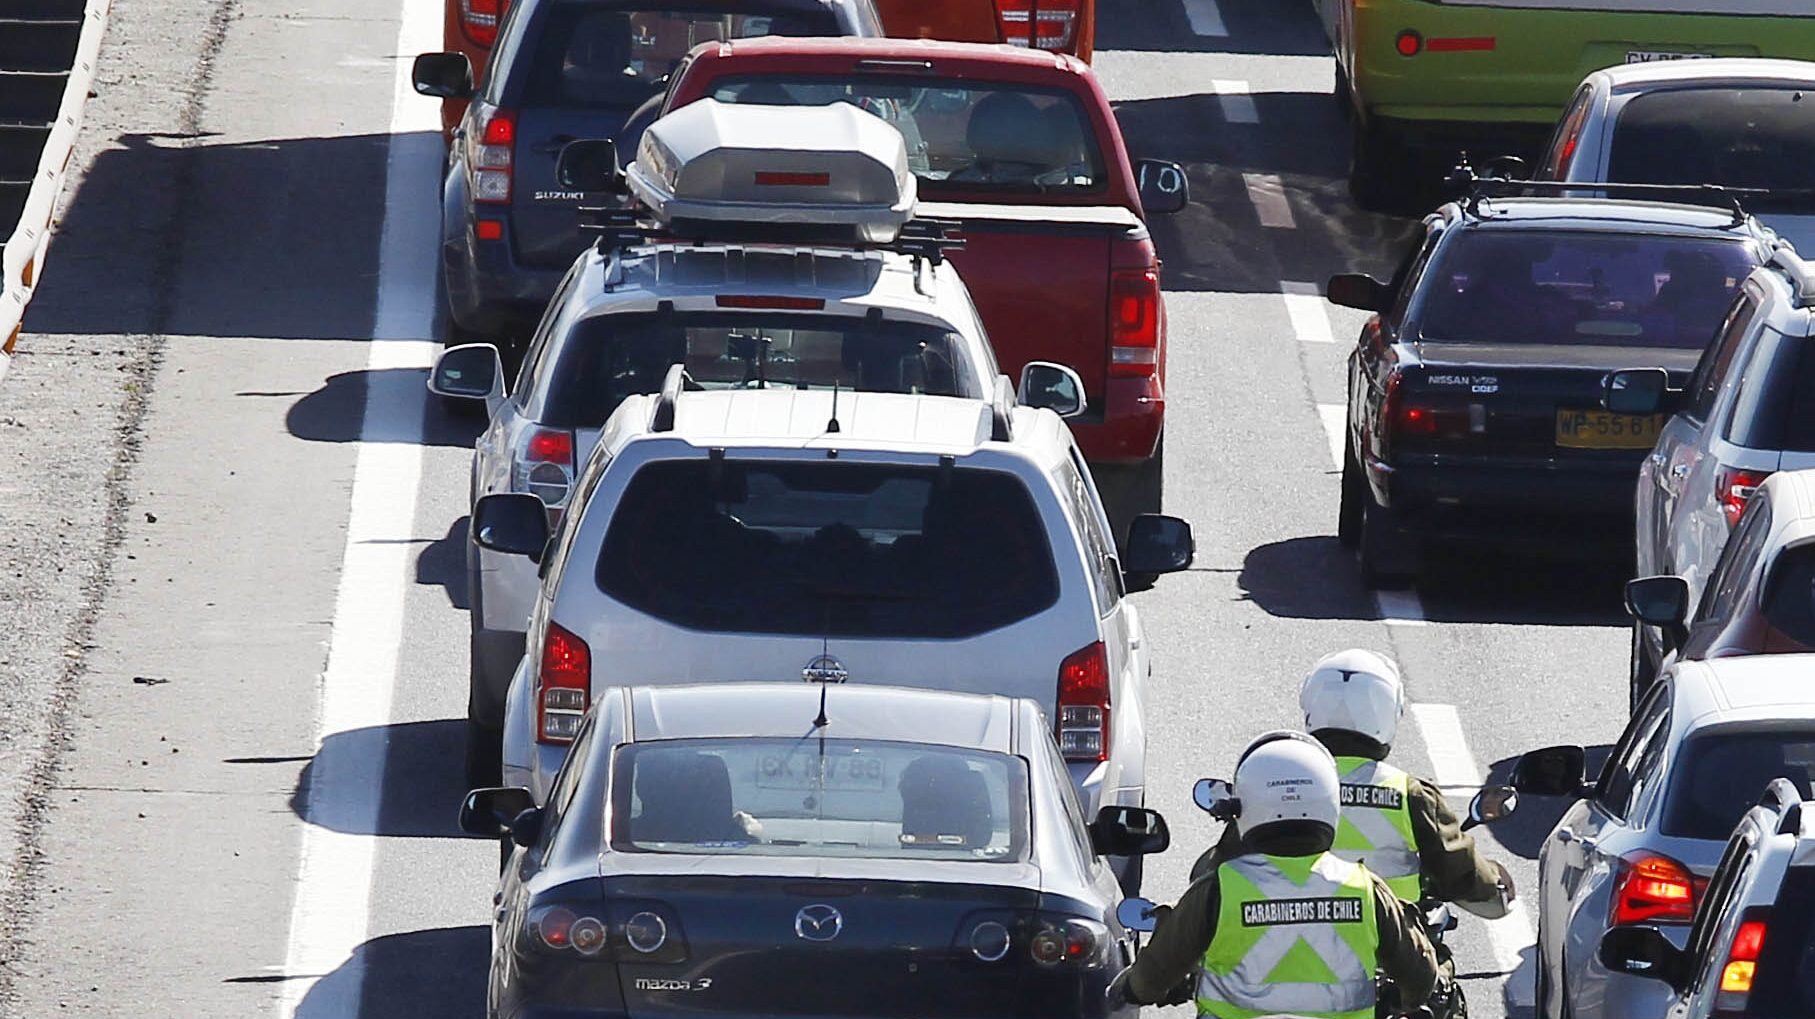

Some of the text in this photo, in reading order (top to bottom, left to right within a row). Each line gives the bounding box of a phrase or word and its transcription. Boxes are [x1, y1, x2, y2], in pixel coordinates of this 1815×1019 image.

[534, 191, 584, 200] SUZUKI
[1428, 375, 1470, 384] NISSAN
[1267, 779, 1313, 787] CARABINEROS
[1356, 787, 1369, 803] DE
[1372, 788, 1399, 806] CHILE
[1244, 901, 1361, 923] CARABINEROS DE CHILE
